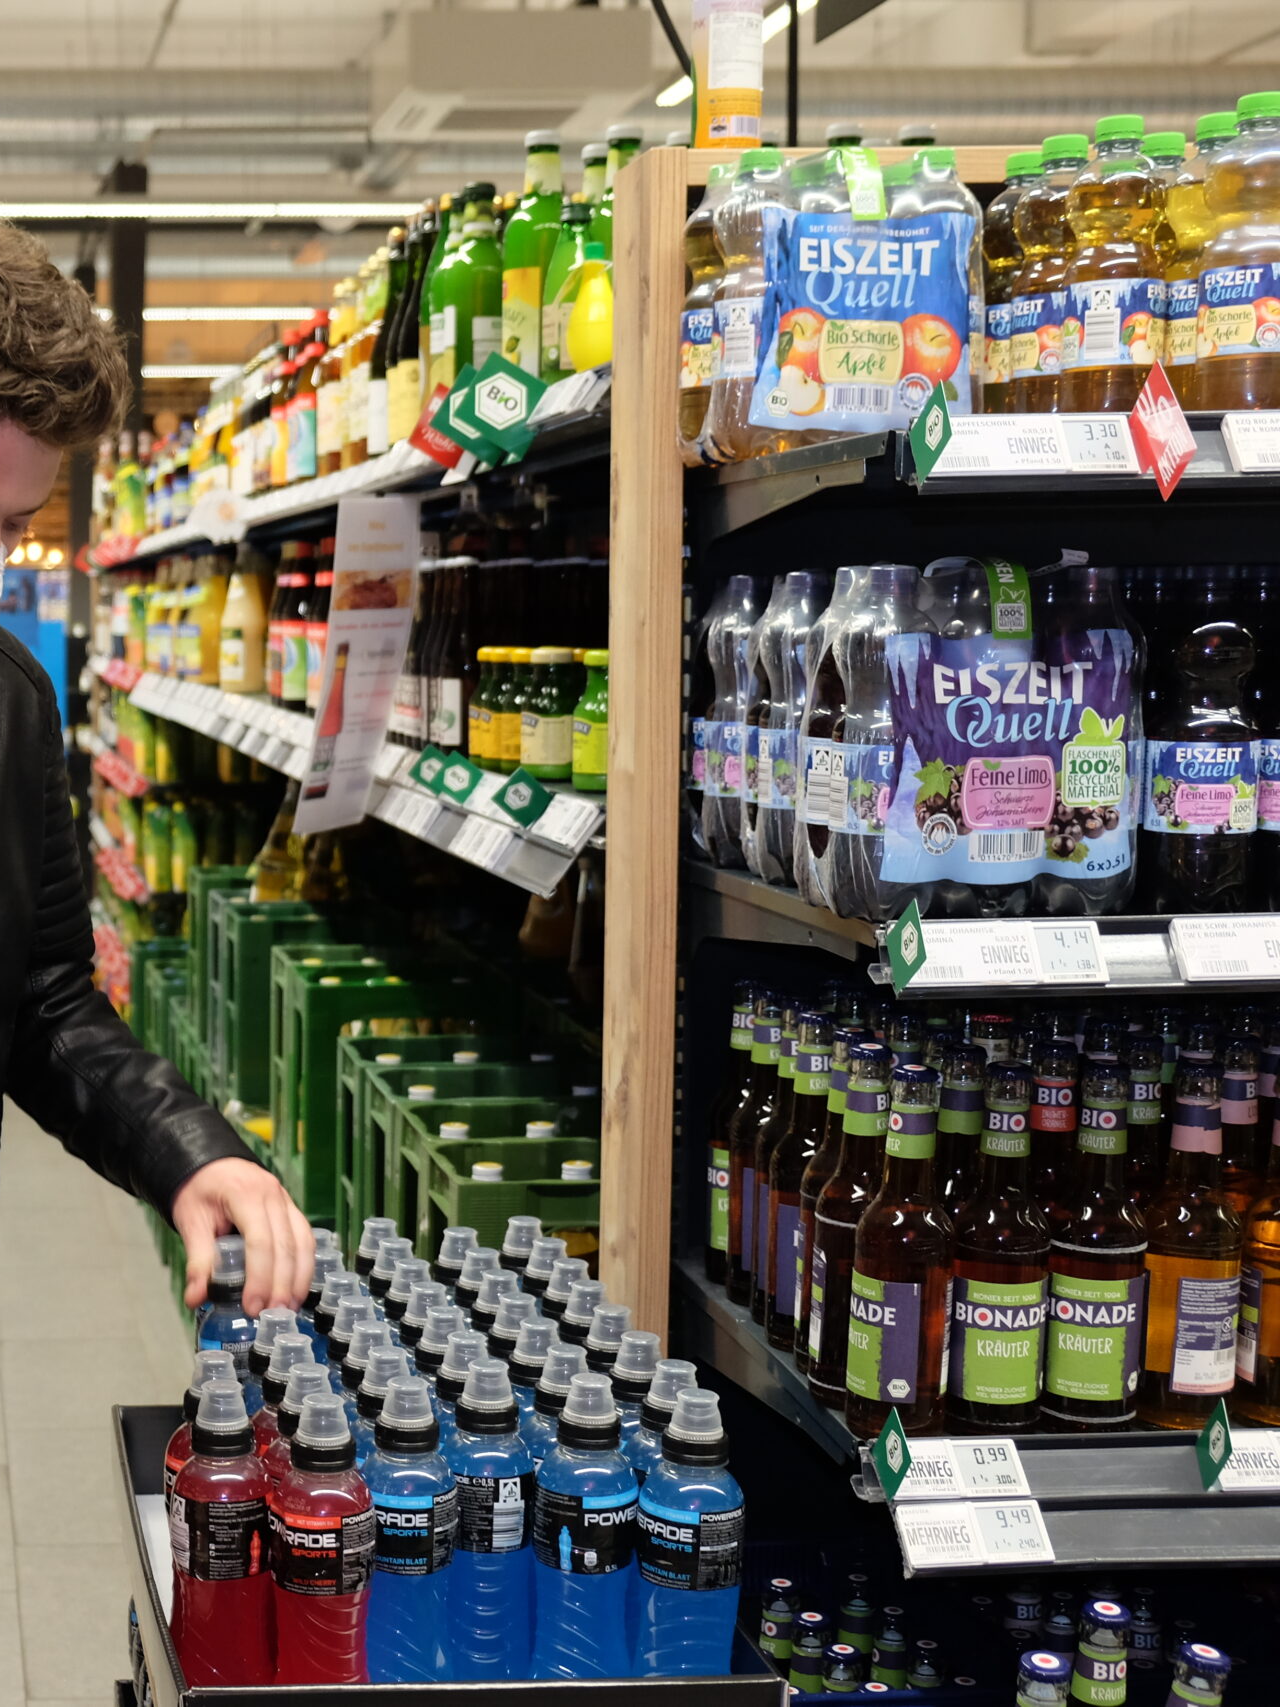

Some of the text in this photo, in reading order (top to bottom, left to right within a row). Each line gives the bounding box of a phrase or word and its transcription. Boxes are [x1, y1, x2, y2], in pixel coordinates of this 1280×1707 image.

[799, 238, 940, 276] EISZEIT
[1205, 269, 1263, 289] EISZEIT
[805, 268, 916, 315] Quell
[1207, 280, 1255, 303] Quell
[826, 329, 899, 350] Bio Schorle
[837, 351, 886, 375] Apfel
[1085, 423, 1118, 441] 3.30
[1007, 437, 1058, 454] EINWEG
[933, 661, 1092, 704] EISZEIT
[946, 695, 1074, 748] Quell
[1069, 750, 1108, 759] FLASCHEN
[1176, 747, 1242, 762] EISZEIT
[1069, 760, 1120, 774] 100%
[1180, 758, 1235, 779] Quell
[972, 767, 1048, 786] Feine Limo
[1068, 785, 1120, 798] MATERIAL
[1181, 789, 1232, 800] Feine Limo
[1054, 931, 1088, 949] 4.14
[981, 945, 1030, 964] EINWEG
[1037, 1087, 1073, 1105] BIO
[989, 1112, 1026, 1132] BIO
[1081, 1110, 1117, 1129] BIO
[986, 1136, 1025, 1152] KRÄUTER
[1078, 1134, 1116, 1150] KRÄUTER
[707, 1166, 729, 1188] BIO
[1003, 1294, 1021, 1303] SEIT
[1084, 1291, 1102, 1299] SEIT
[955, 1301, 1047, 1329] BIONADE
[977, 1338, 1031, 1358] KRÄUTER
[1058, 1332, 1113, 1354] KRÄUTER
[892, 1383, 906, 1391] BIO
[973, 1447, 1008, 1465] 0.99
[376, 1510, 429, 1527] RADE
[996, 1509, 1031, 1529] 9.49
[383, 1528, 428, 1537] SPORTS
[906, 1525, 971, 1546] MEHRWEG
[291, 1548, 337, 1558] SPORTS
[651, 1536, 693, 1553] SPORTS
[375, 1555, 428, 1565] OUNTAIN BLAST
[670, 1572, 691, 1581] BLAST
[1093, 1661, 1126, 1680] BIO
